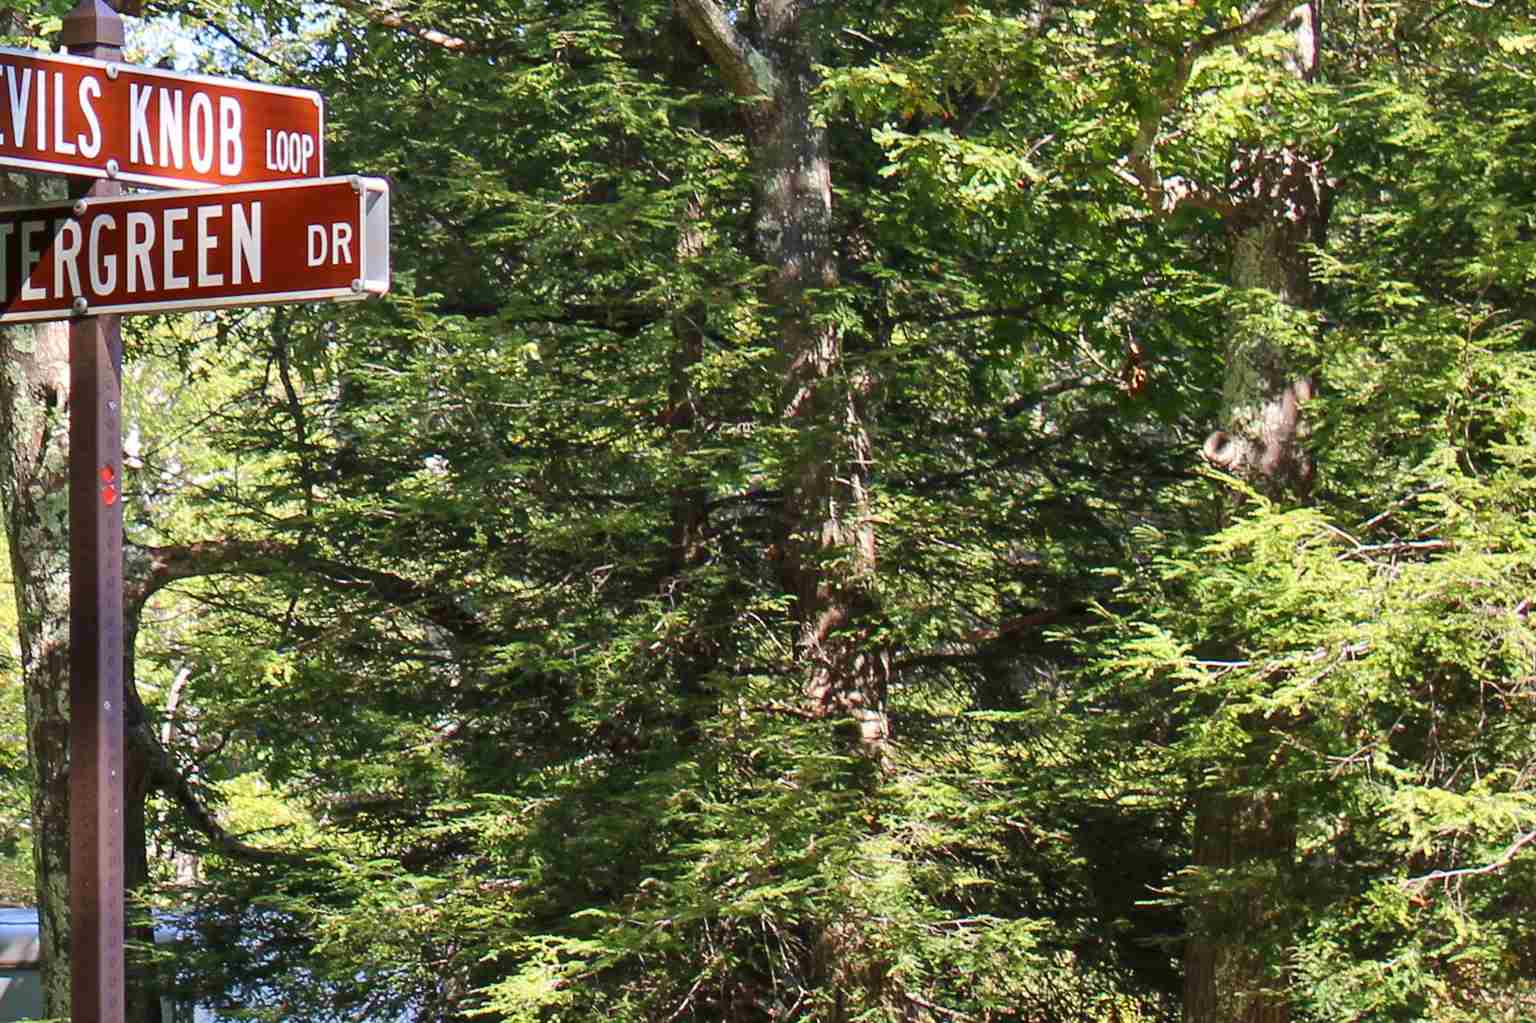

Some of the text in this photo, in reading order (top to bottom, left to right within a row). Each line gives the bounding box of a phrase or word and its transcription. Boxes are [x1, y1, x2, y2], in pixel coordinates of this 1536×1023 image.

[129, 81, 244, 177] KNOB
[266, 128, 314, 175] LOOP
[306, 222, 353, 268] DR
